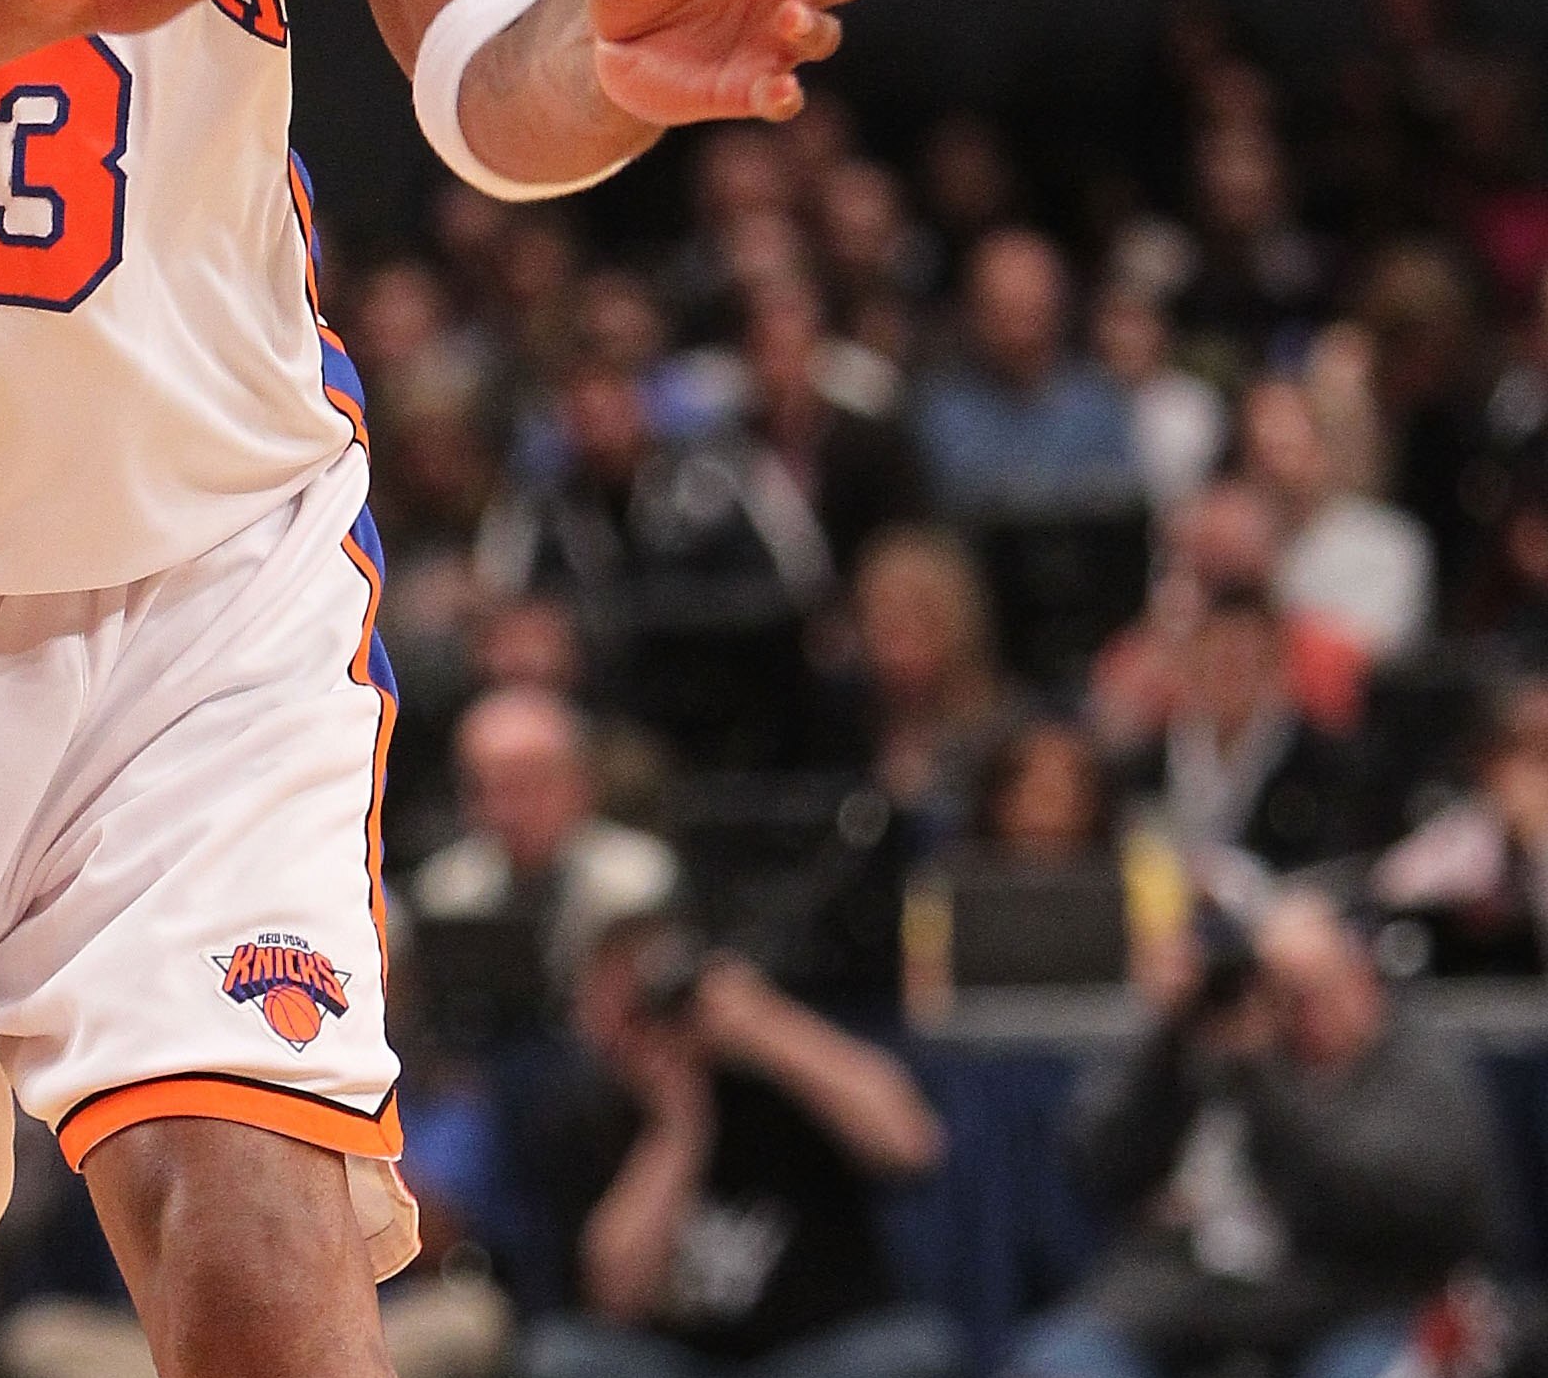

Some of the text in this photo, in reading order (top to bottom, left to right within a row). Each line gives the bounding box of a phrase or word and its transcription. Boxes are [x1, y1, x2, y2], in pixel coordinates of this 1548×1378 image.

[257, 932, 311, 951] NEW YORK
[223, 942, 349, 1016] KNICKS
